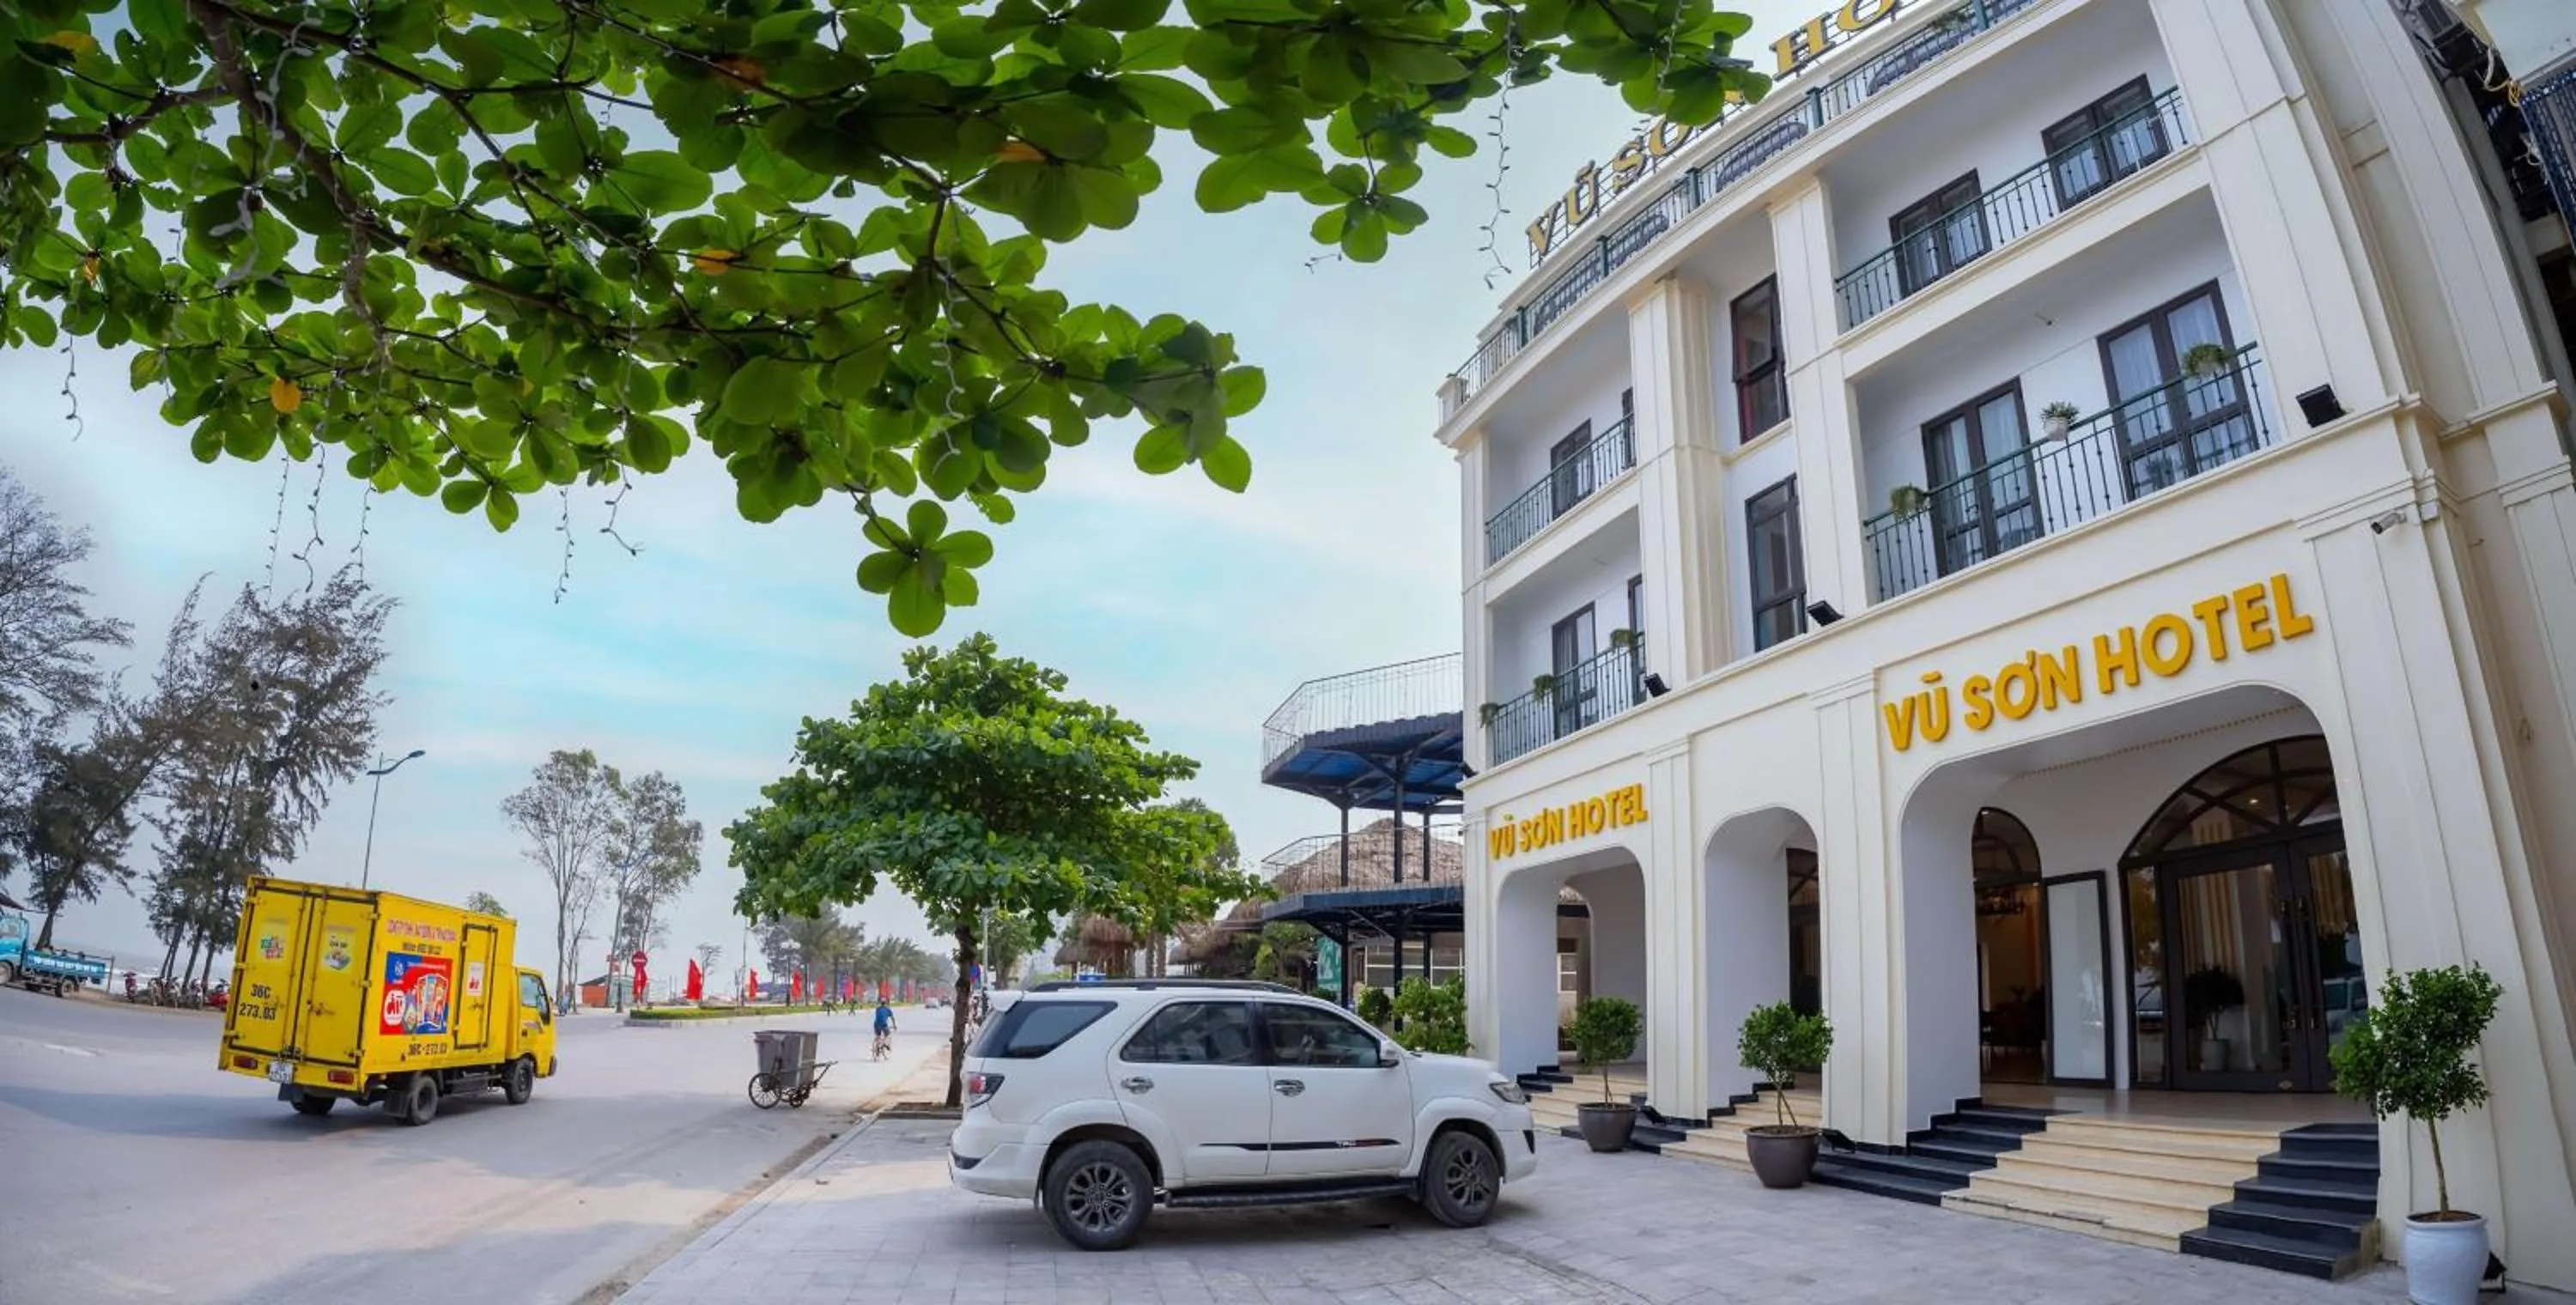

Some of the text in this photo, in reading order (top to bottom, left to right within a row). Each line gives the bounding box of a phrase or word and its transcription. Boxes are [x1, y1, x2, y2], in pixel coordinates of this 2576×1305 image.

[1884, 573, 2314, 751] VŨ SƠN HOTEL
[1490, 782, 1649, 860] VŨ SƠN HOTEL
[251, 983, 271, 999] 36C
